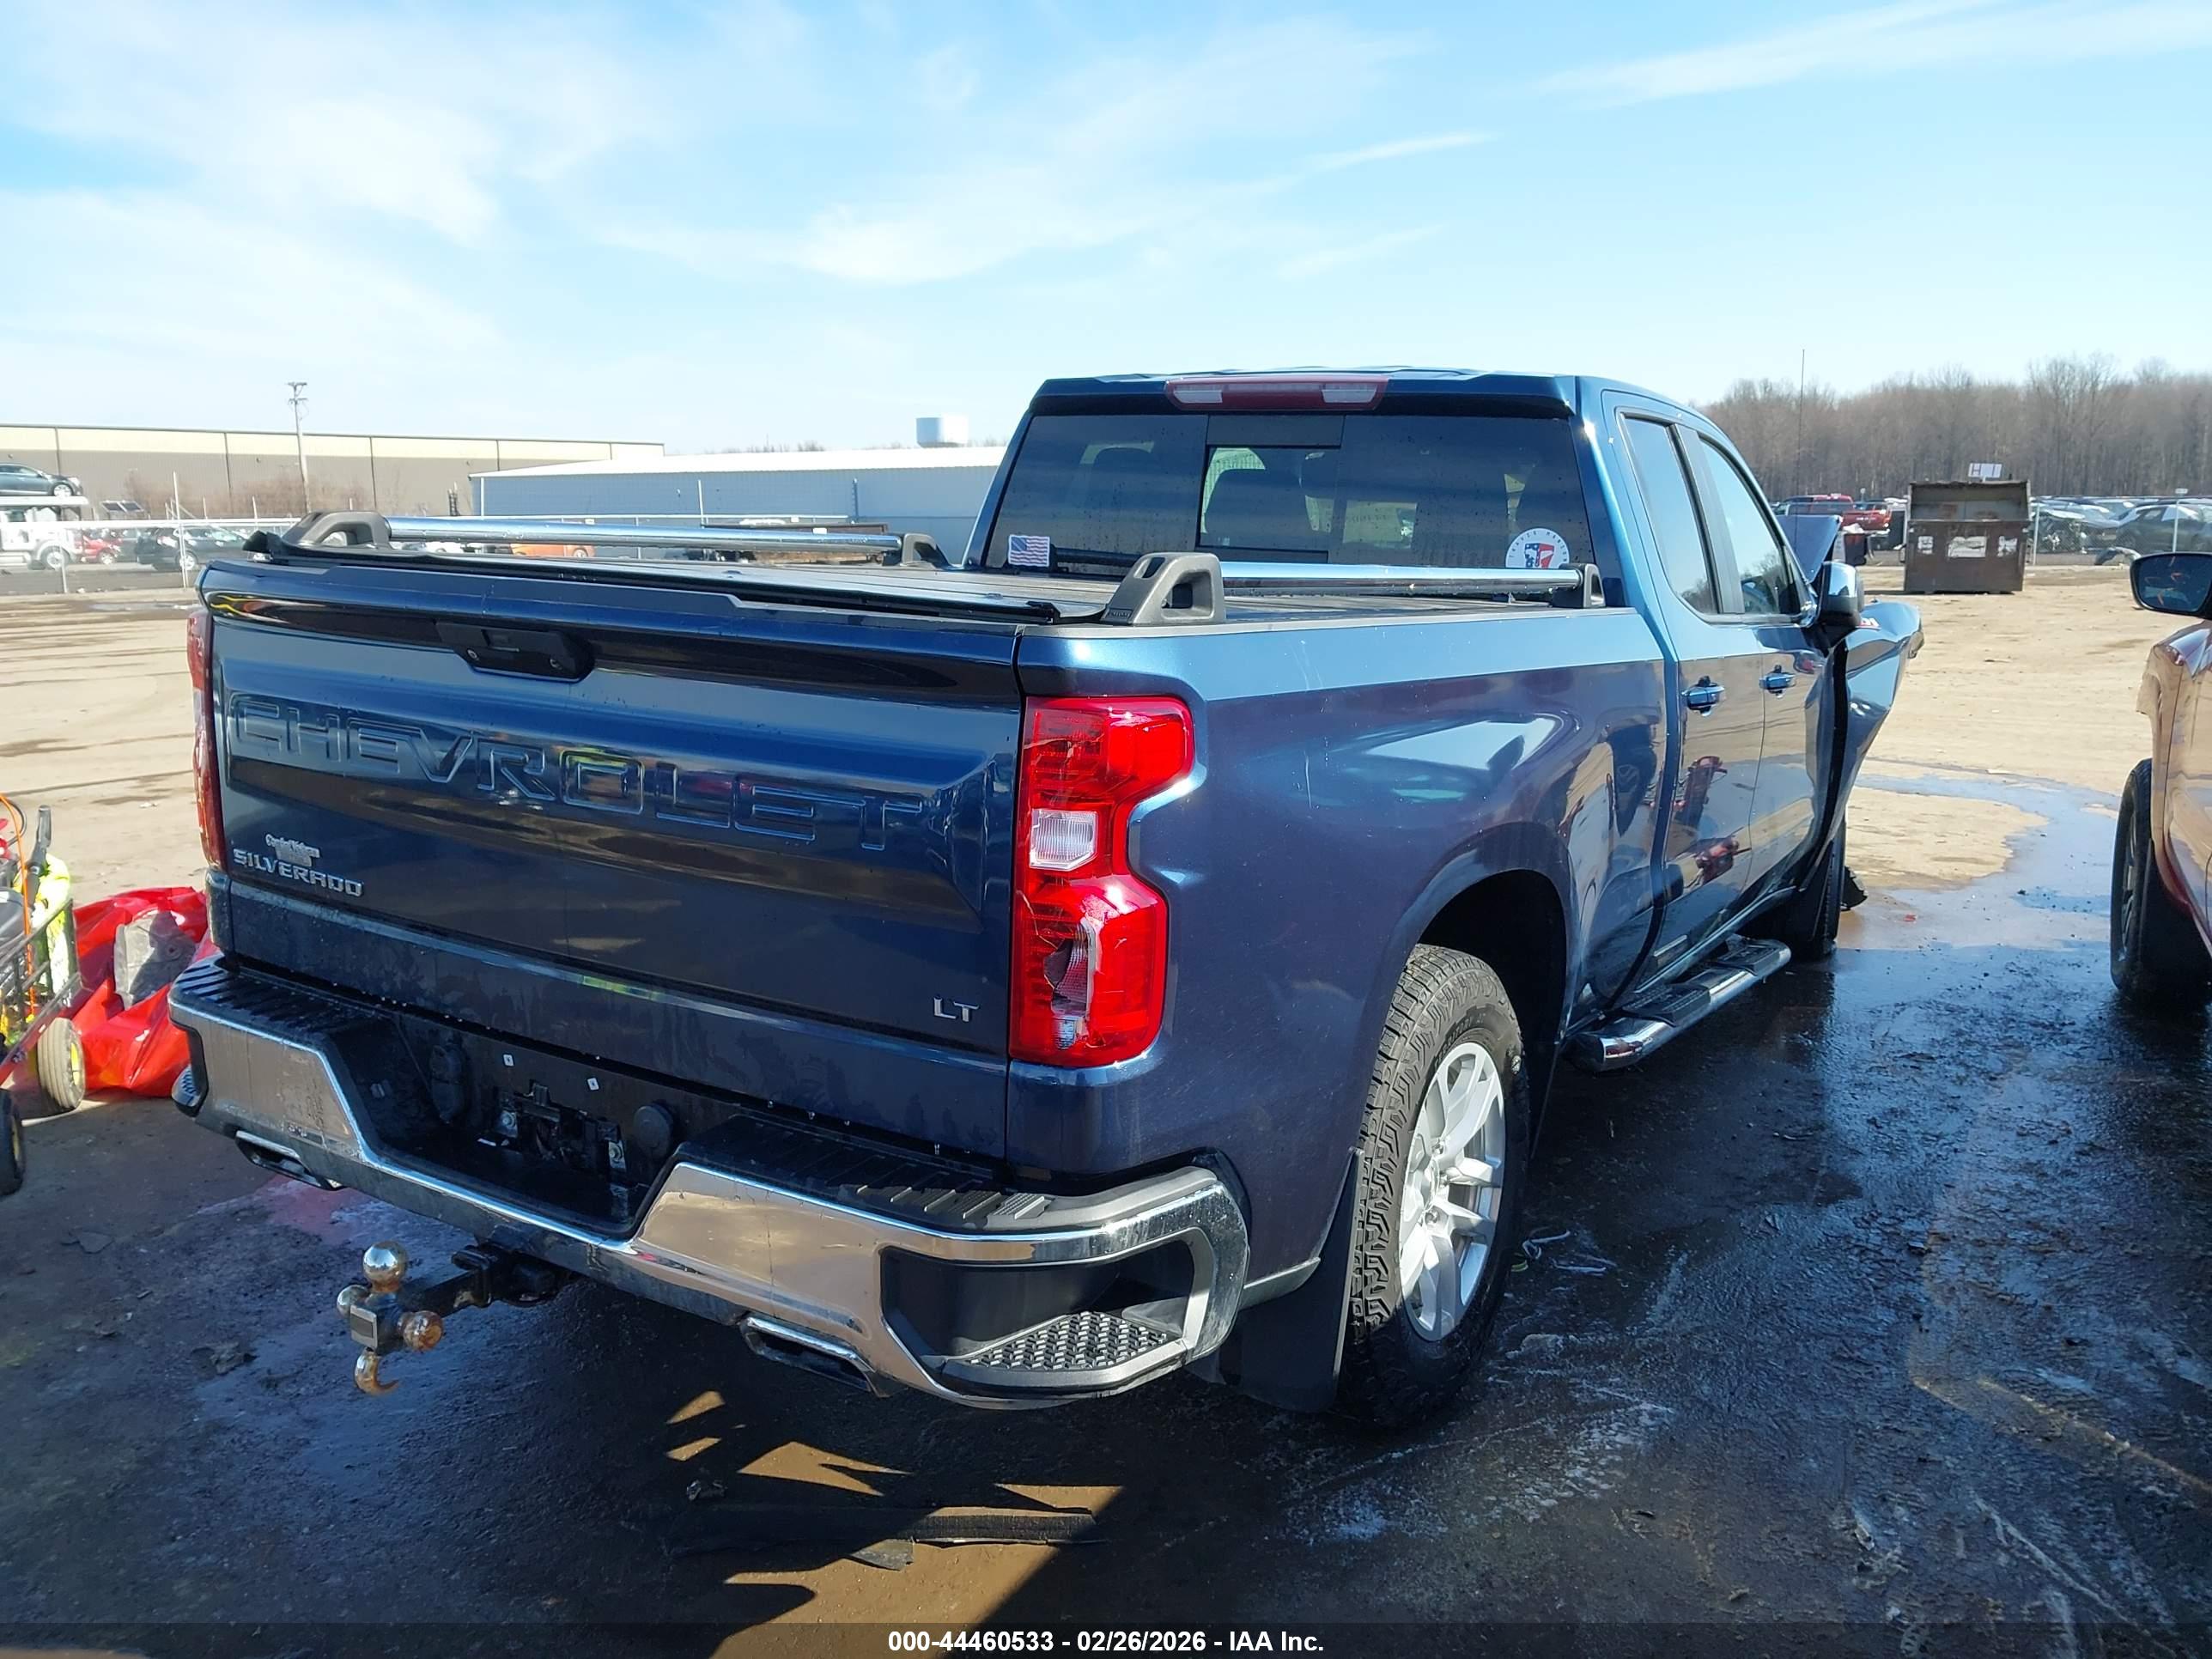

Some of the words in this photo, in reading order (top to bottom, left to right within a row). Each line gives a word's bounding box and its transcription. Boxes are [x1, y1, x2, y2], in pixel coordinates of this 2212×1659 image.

[234, 695, 924, 852] CHEVROLET
[233, 848, 364, 897] SILVERADO
[933, 996, 980, 1023] LT
